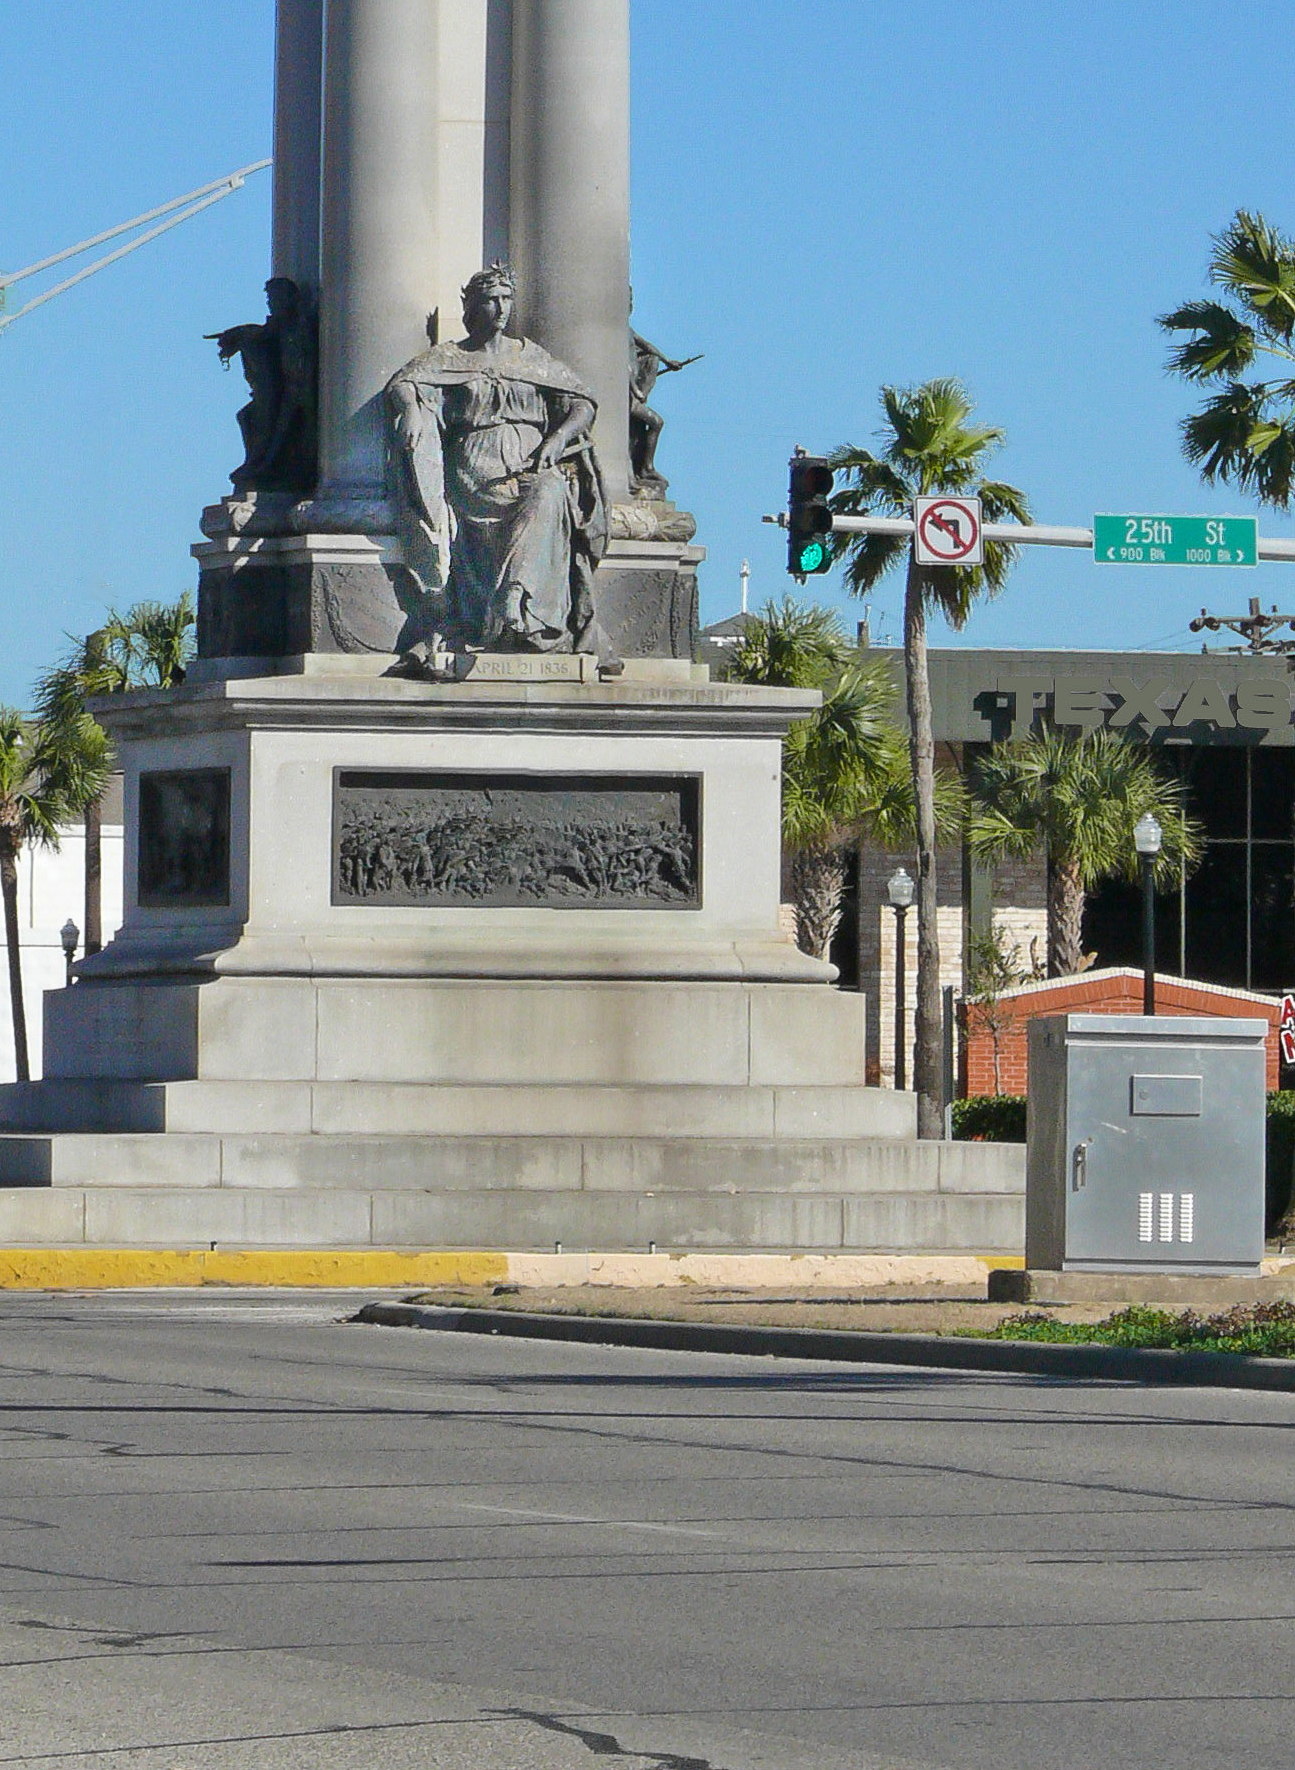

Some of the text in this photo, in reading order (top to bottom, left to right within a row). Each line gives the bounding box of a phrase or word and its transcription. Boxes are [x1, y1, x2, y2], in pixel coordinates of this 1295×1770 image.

[1125, 519, 1227, 546] 25th St
[1120, 547, 1143, 560] 900
[1186, 548, 1211, 562] 1000
[997, 676, 1292, 729] TEXAS
